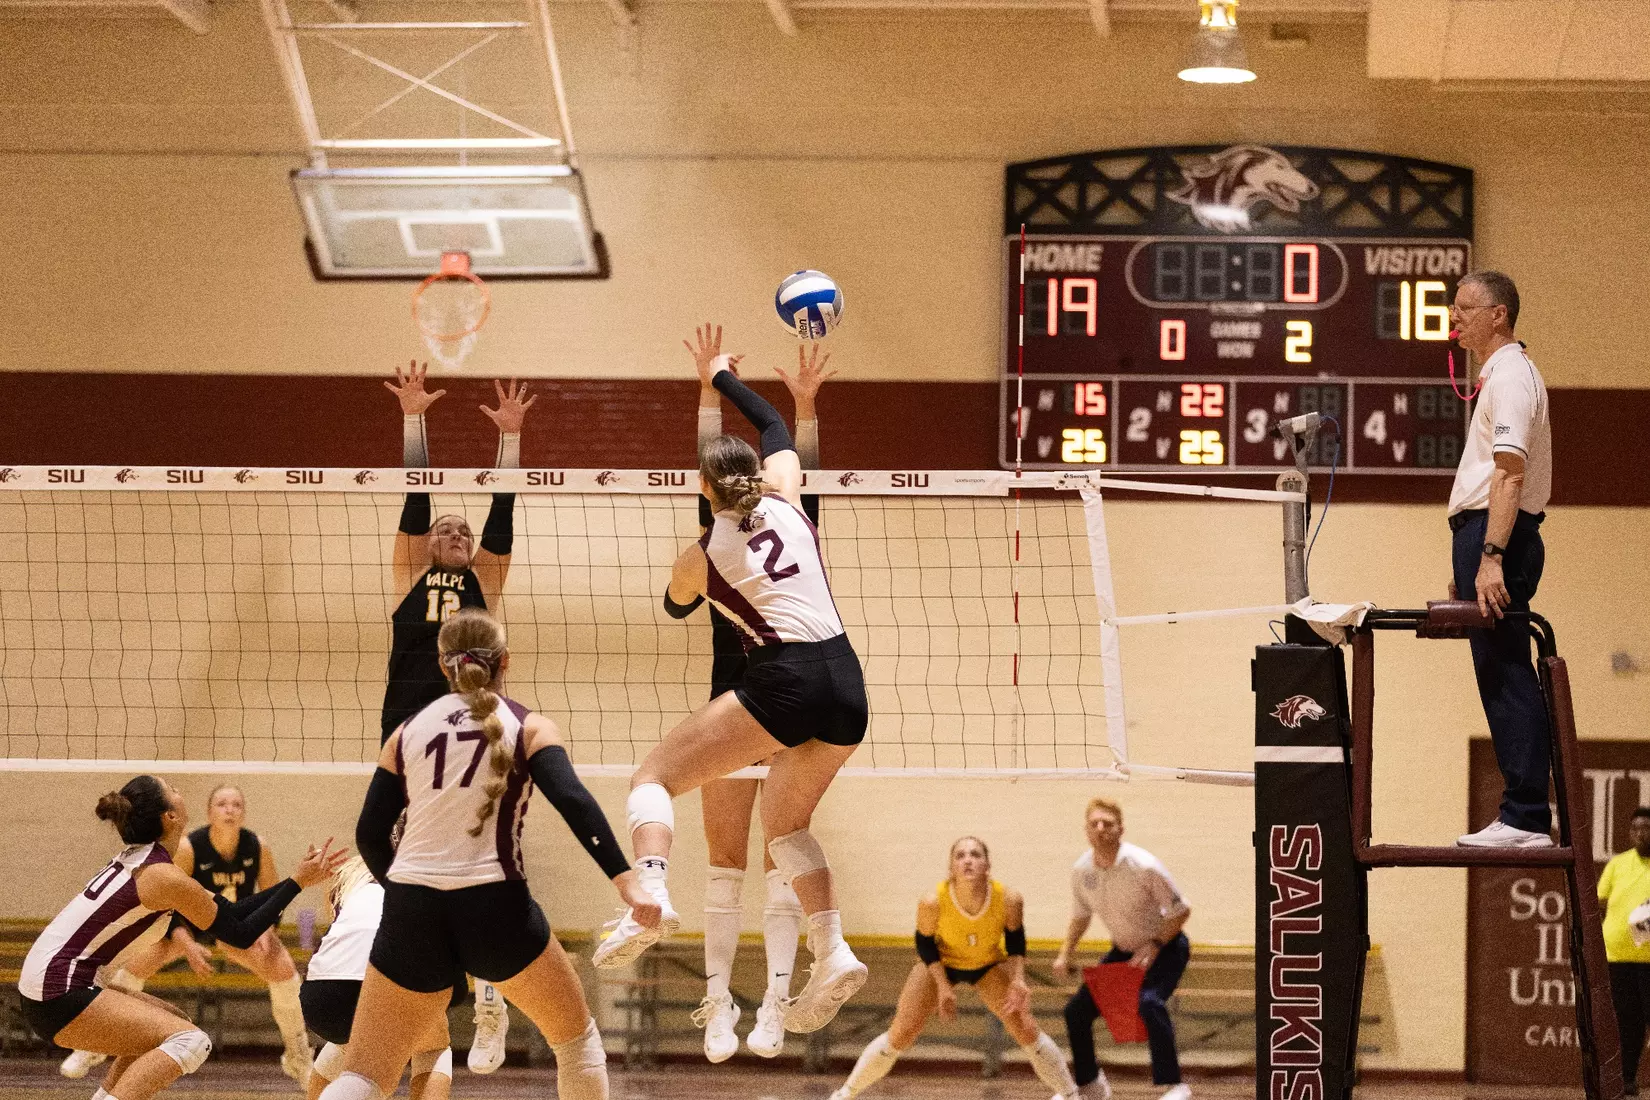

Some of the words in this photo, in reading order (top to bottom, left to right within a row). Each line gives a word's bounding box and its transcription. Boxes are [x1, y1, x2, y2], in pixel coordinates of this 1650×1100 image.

[1023, 243, 1104, 272] HOME
[1284, 244, 1318, 303] 0
[1364, 247, 1464, 275] VISITOR
[1047, 278, 1097, 336] 19
[1400, 281, 1450, 341] 16
[1160, 319, 1186, 360] 0
[1285, 320, 1312, 362] 2
[1075, 382, 1107, 416] 15
[1180, 383, 1224, 417] 22
[1127, 407, 1152, 442] 2
[1244, 408, 1268, 443] 3
[1363, 410, 1387, 445] 4
[1037, 435, 1053, 458] V
[1062, 428, 1107, 463] 25
[1156, 436, 1172, 459] V
[1179, 430, 1224, 465] 25
[1392, 440, 1407, 463] V
[48, 469, 85, 483] SIU
[167, 470, 204, 484] SIU
[286, 470, 323, 484] SIU
[406, 471, 444, 485] SIU
[527, 471, 564, 486] SIU
[648, 472, 685, 486] SIU
[891, 473, 929, 487] SIU
[746, 528, 800, 583] 2
[425, 589, 461, 624] 12
[425, 730, 490, 790] 17
[84, 859, 125, 901] 0
[1269, 822, 1323, 1100] SALUKIS
